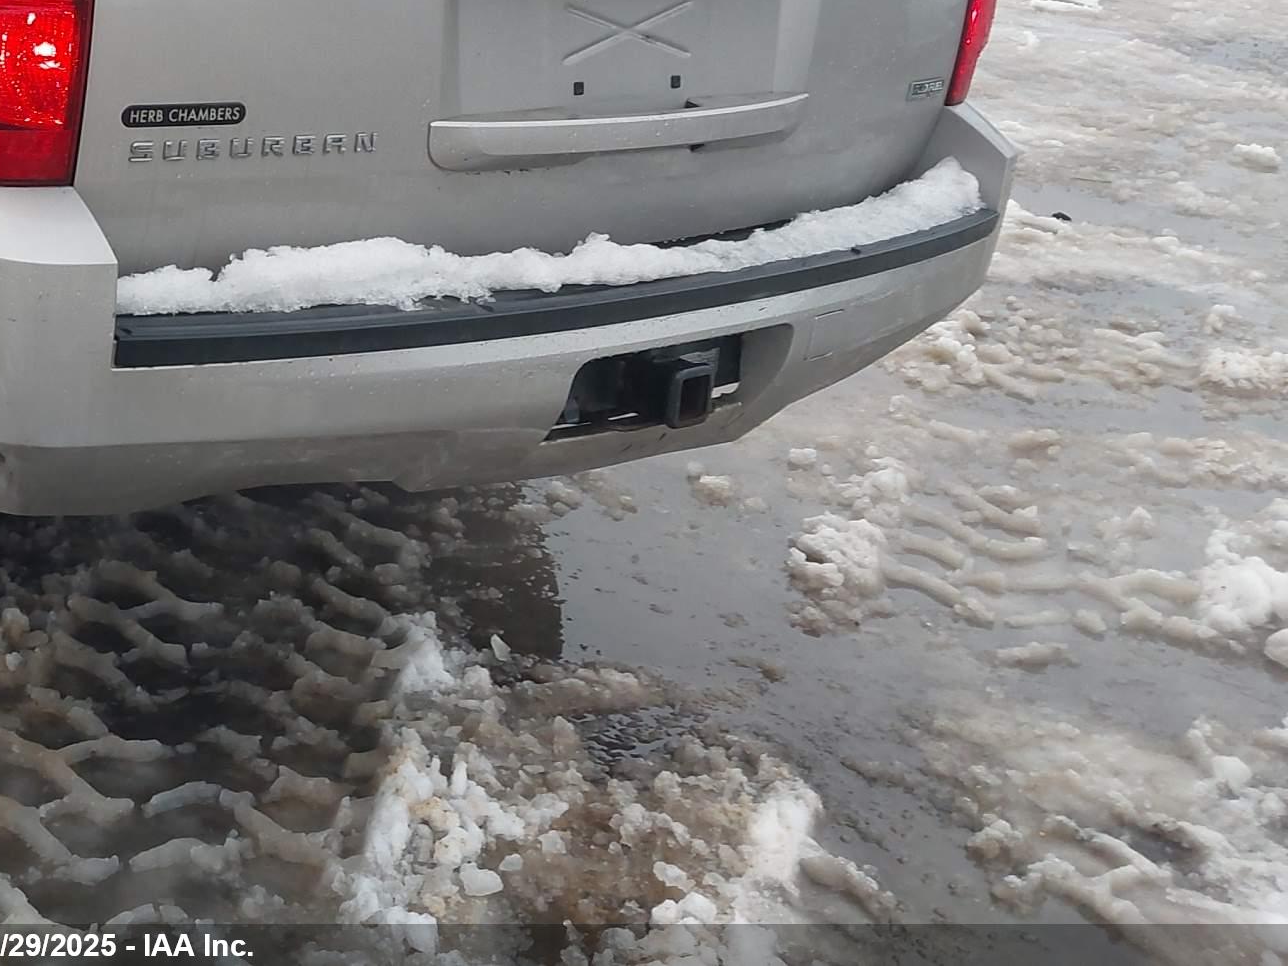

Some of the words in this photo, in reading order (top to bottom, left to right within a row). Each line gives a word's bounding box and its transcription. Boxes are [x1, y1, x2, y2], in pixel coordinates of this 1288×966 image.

[129, 109, 164, 123] HERB
[168, 107, 241, 123] CHAMBERS
[128, 132, 378, 163] SUBURBAN
